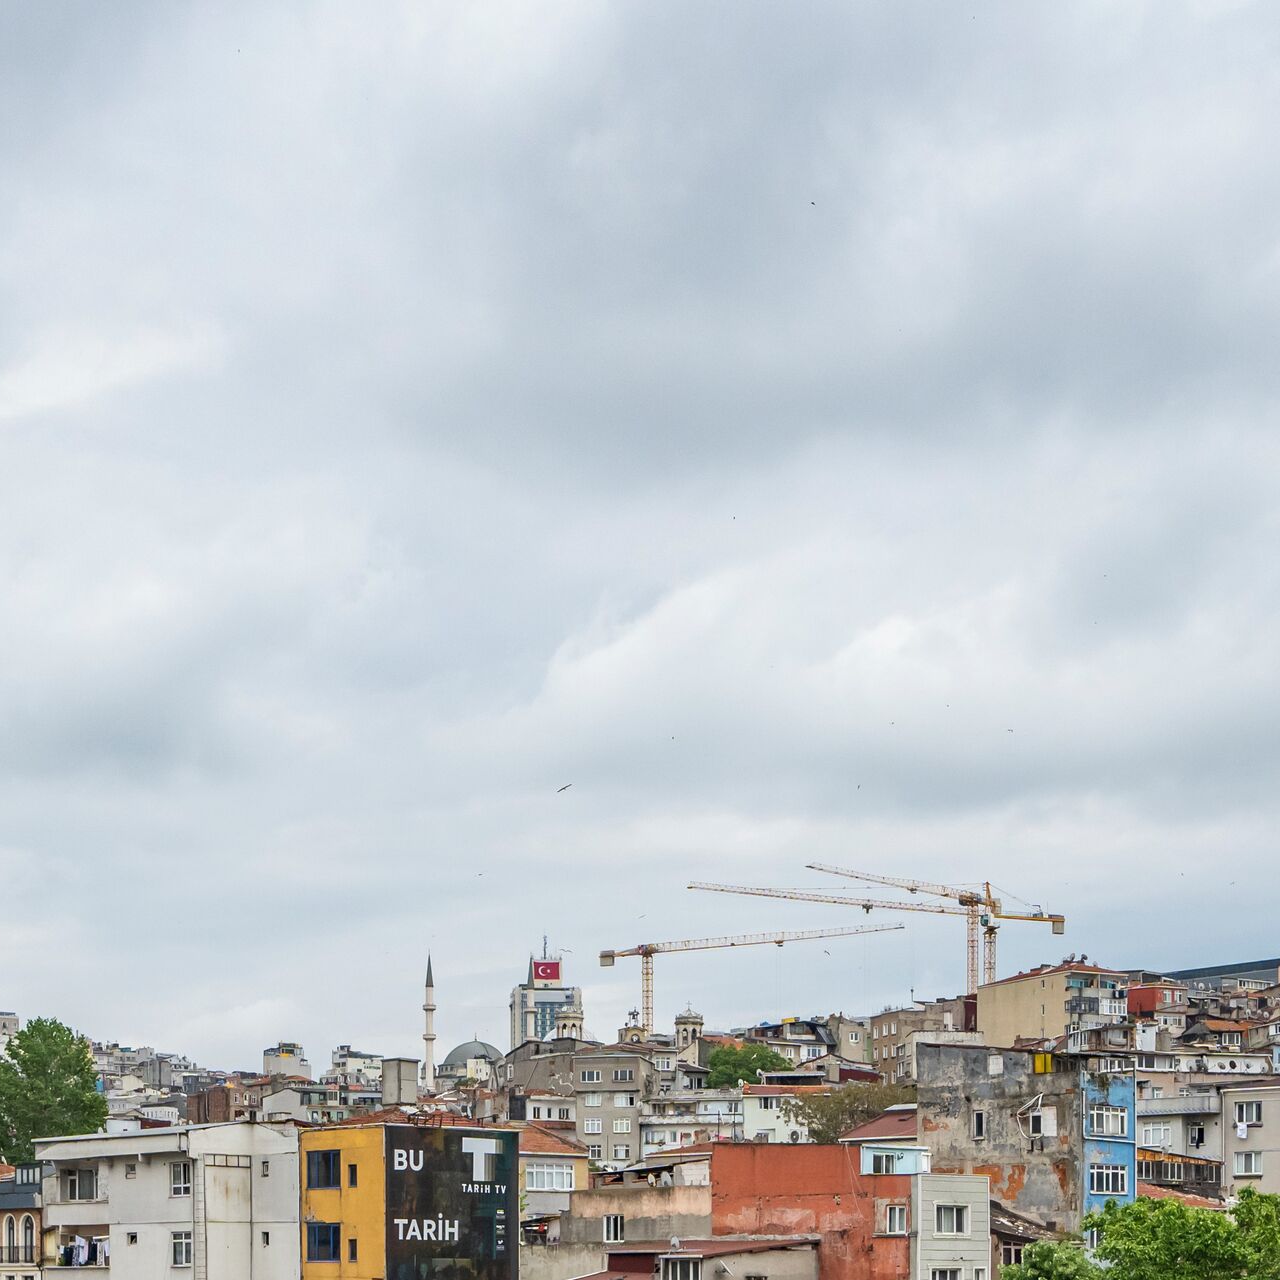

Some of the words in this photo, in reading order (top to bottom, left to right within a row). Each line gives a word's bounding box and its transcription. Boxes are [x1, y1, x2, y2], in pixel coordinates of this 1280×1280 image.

[394, 1149, 424, 1172] BU
[495, 1184, 507, 1194] TV
[394, 1213, 459, 1241] TARİH
